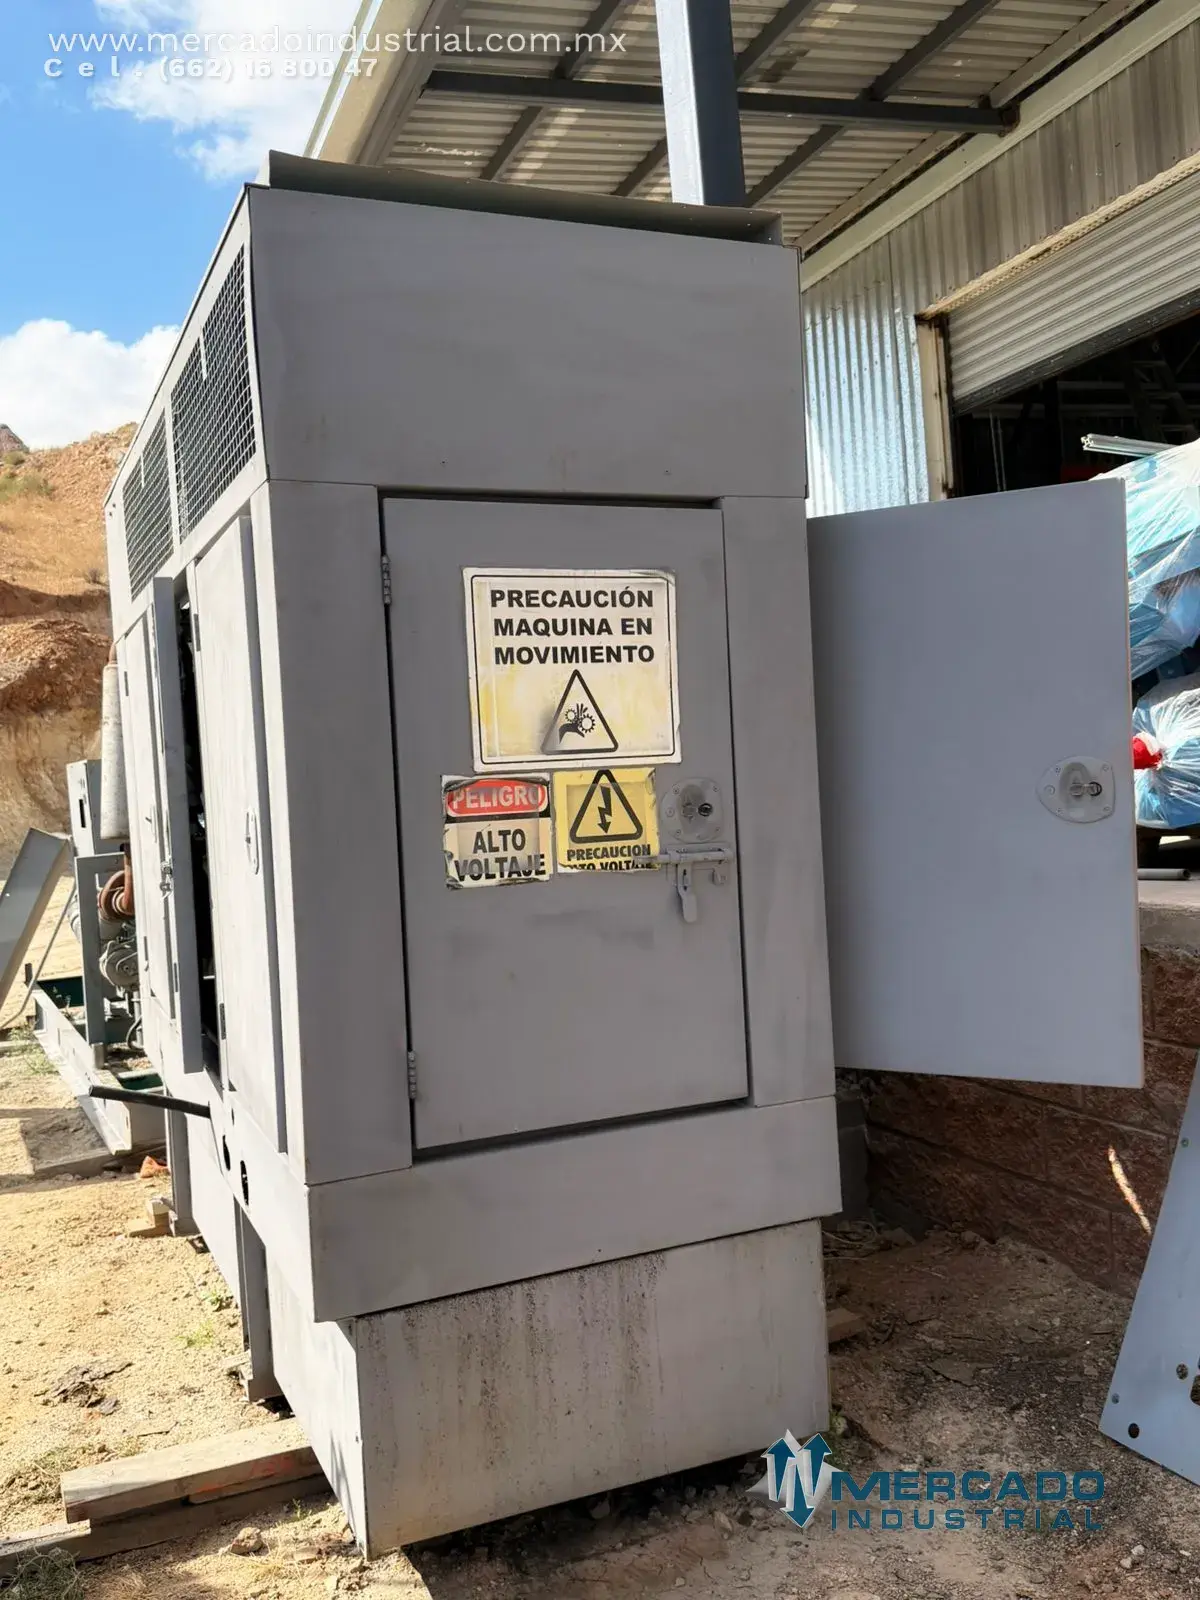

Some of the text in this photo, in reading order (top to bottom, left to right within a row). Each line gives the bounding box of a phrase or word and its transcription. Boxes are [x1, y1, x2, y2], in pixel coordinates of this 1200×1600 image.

[490, 586, 653, 608] PRECAUCIÓN
[494, 618, 652, 637] MAQUINA EN
[495, 645, 654, 665] MOVIMIENTO
[452, 785, 541, 809] PELIGRO
[472, 828, 526, 854] ALTO
[566, 844, 652, 861] PRECAUCION
[454, 853, 546, 882] VOLTAJE
